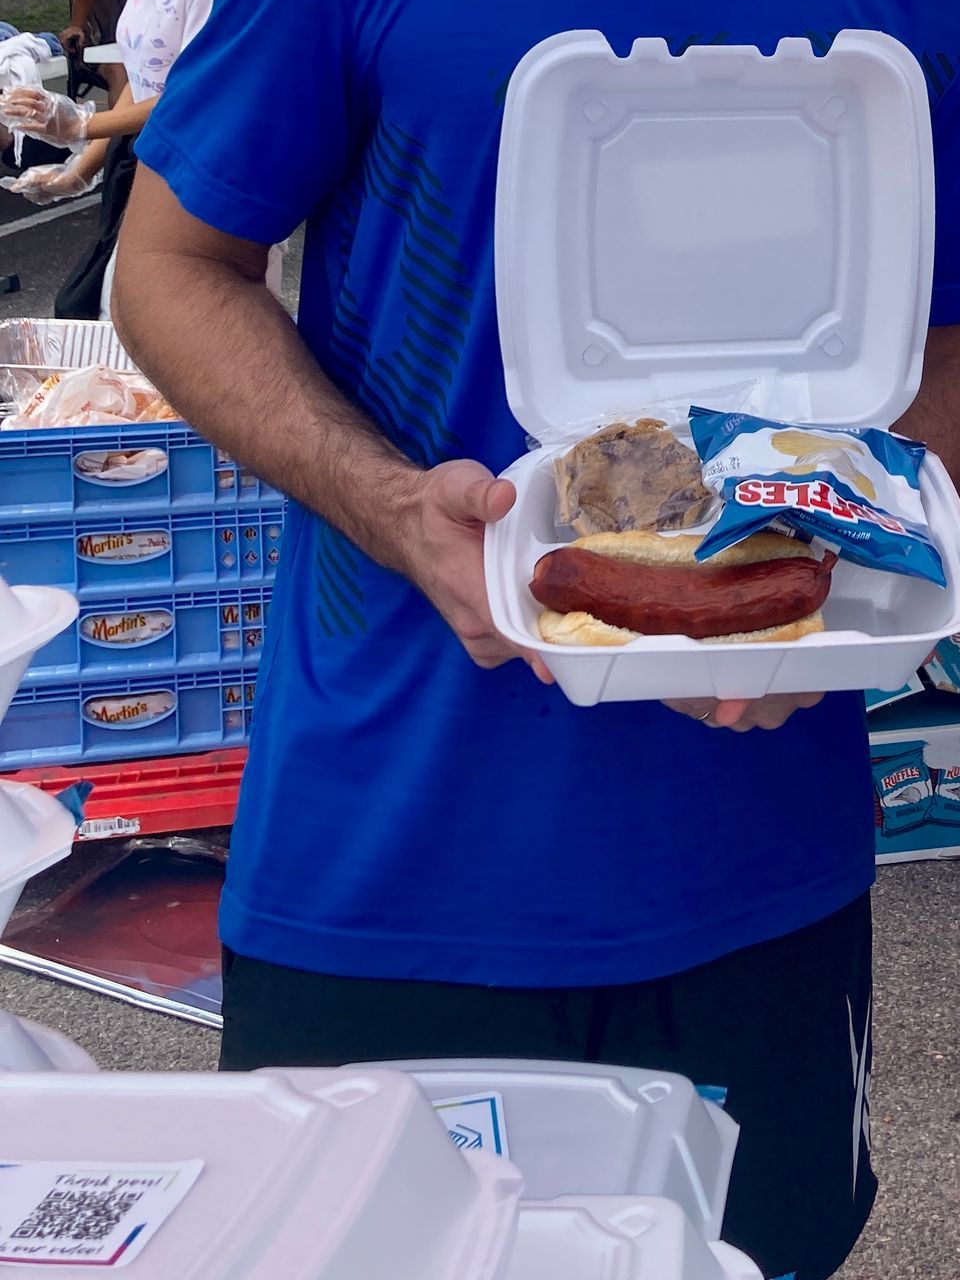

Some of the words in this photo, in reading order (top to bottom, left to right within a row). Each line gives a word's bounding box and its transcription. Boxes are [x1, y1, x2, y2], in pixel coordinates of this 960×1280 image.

[80, 533, 133, 557] Martin's
[92, 613, 146, 640] Martin's
[92, 702, 147, 722] Martin's
[883, 766, 920, 788] RUFFLES
